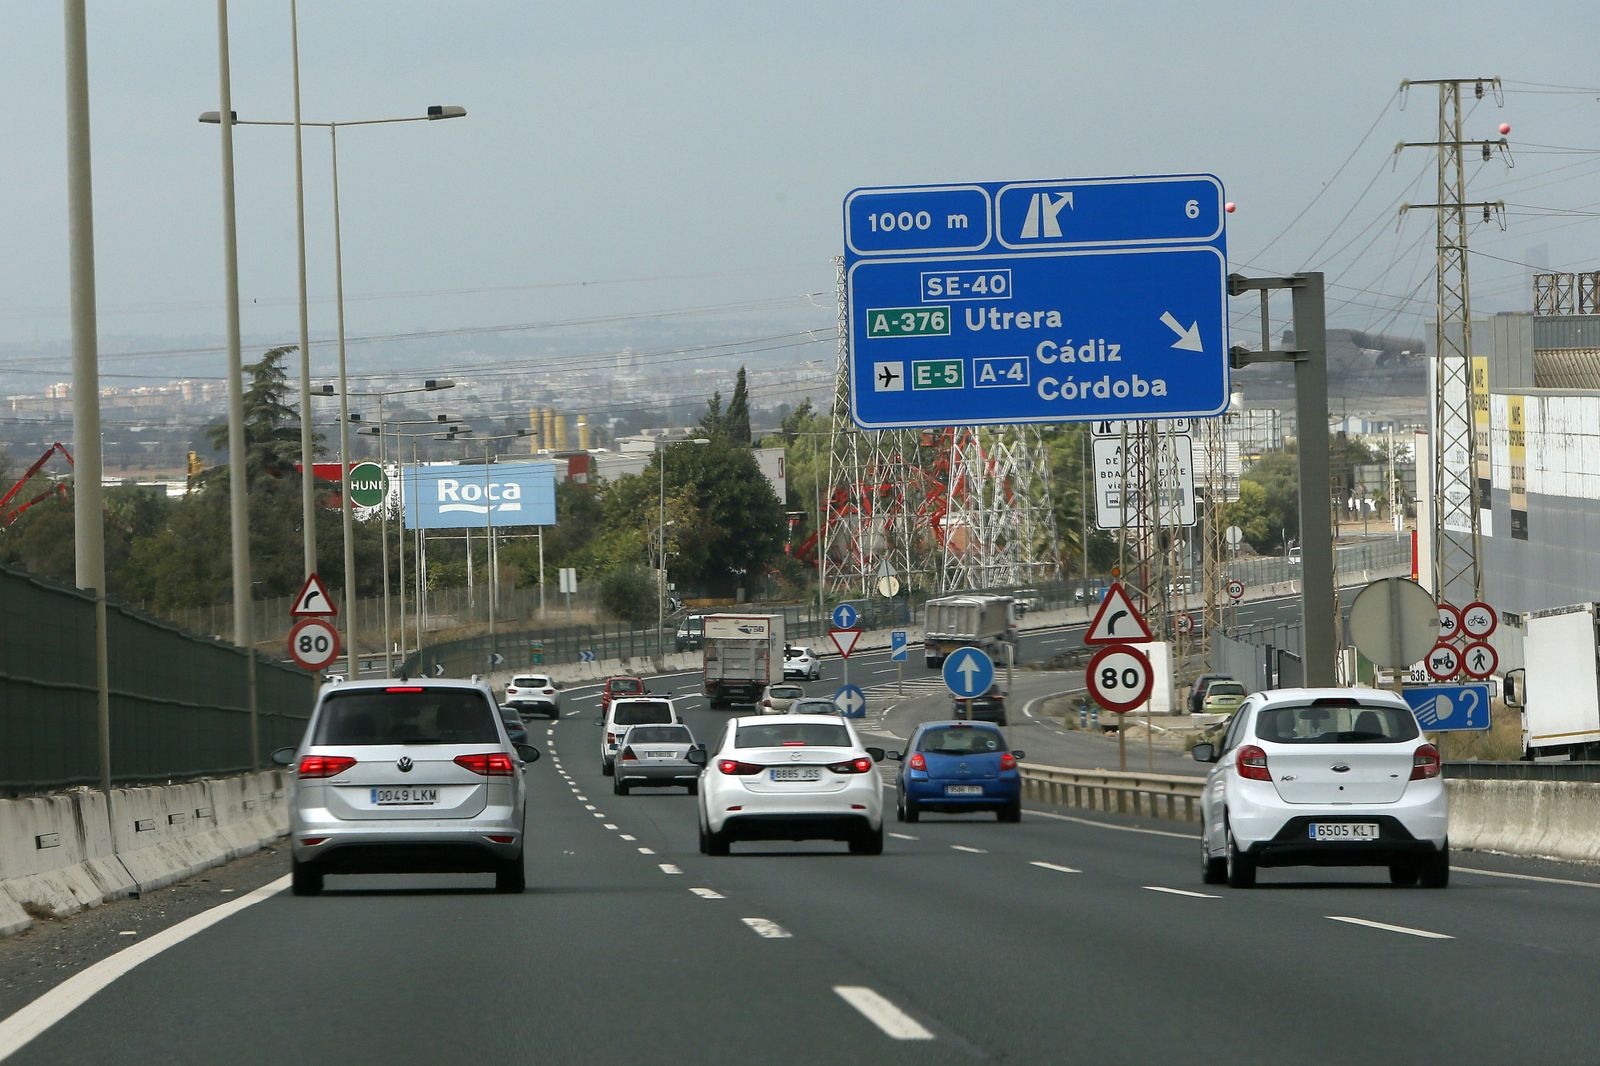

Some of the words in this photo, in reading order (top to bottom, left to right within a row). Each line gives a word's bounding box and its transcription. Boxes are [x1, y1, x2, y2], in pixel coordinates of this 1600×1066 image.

[1185, 199, 1201, 219] 6
[868, 210, 932, 232] 1000
[947, 212, 969, 230] m
[927, 274, 1007, 296] SE-40
[872, 312, 946, 333] A-376
[965, 306, 1063, 331] Utrera
[1035, 338, 1122, 364] Cádiz
[917, 363, 959, 385] E-5
[979, 359, 1024, 383] A-4
[1037, 373, 1168, 401] Córdoba
[437, 478, 522, 502] Roca
[299, 635, 329, 653] 80
[1101, 667, 1139, 690] 80
[1410, 669, 1425, 681] 636
[377, 790, 409, 801] 0049
[412, 789, 437, 801] LKM
[1318, 825, 1349, 836] 6505
[1353, 825, 1376, 836] KLT
